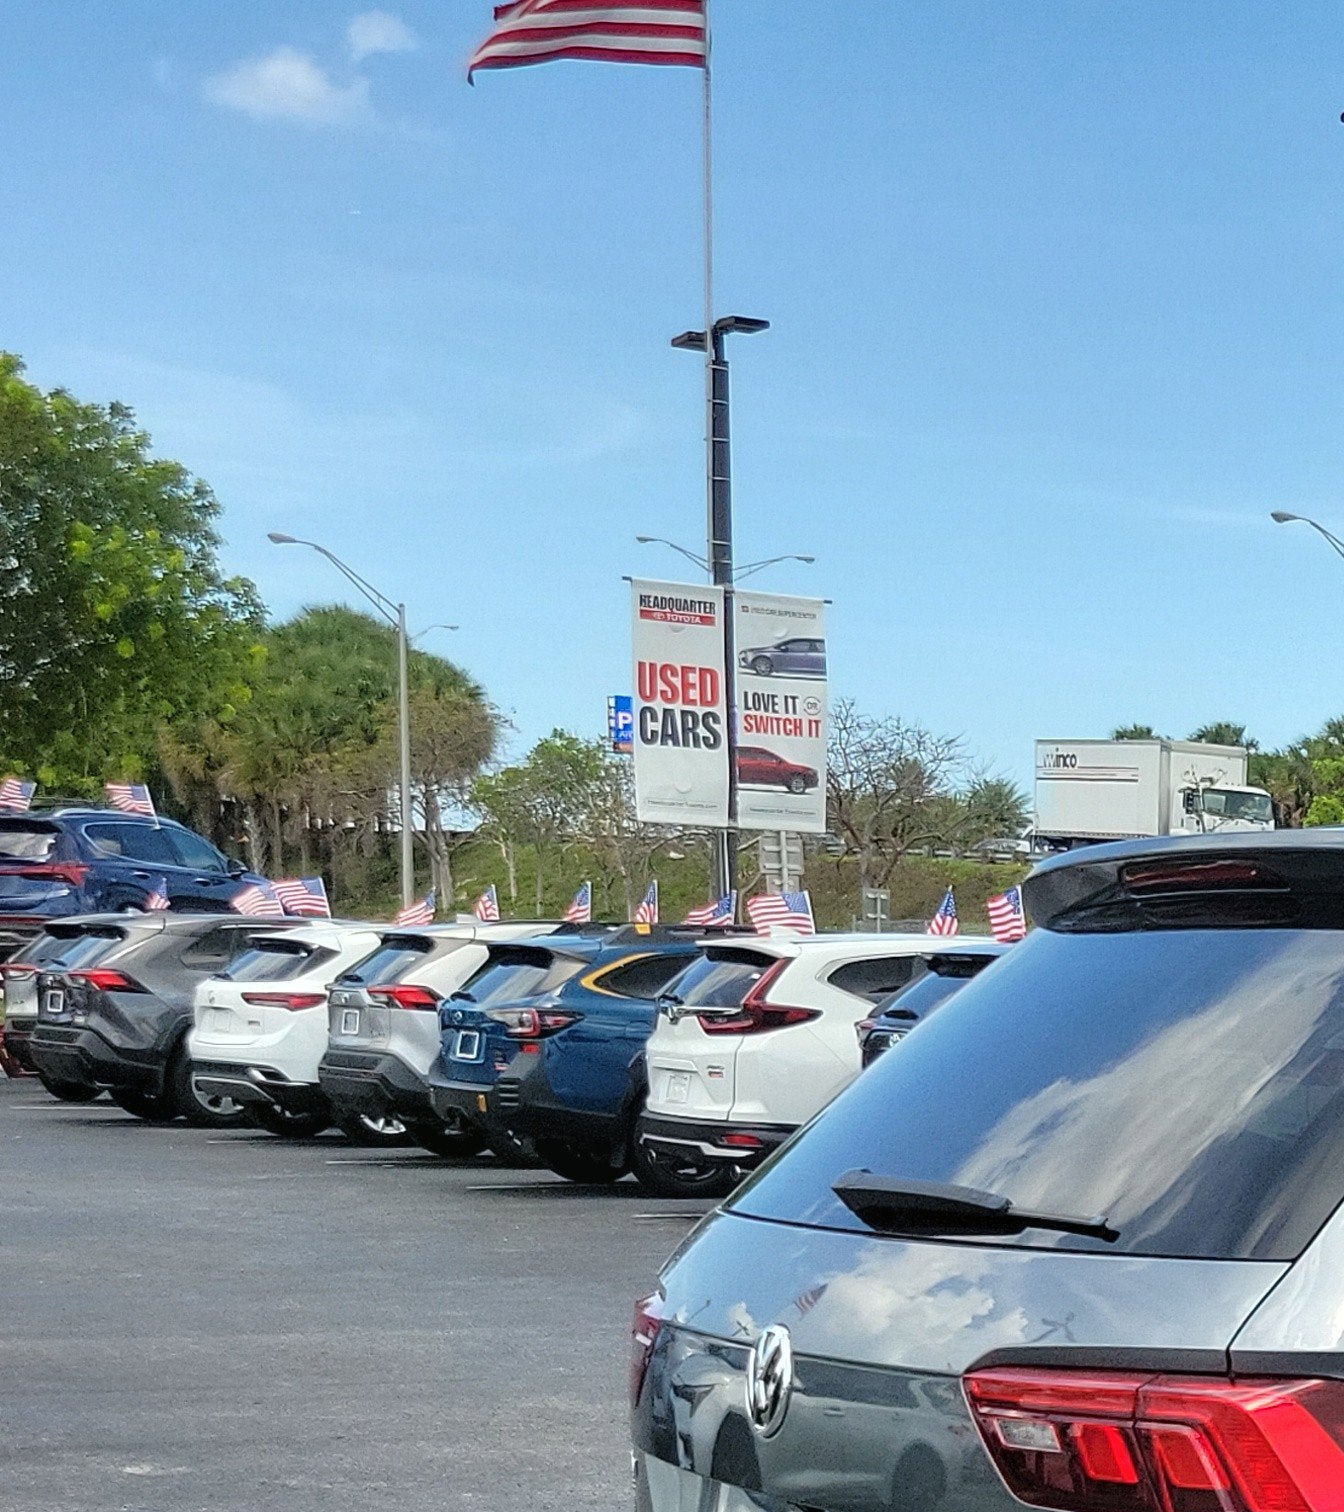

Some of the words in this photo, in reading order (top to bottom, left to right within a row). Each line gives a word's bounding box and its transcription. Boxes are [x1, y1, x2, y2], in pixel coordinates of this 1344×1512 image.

[639, 594, 716, 615] HEADQUARTER
[666, 612, 702, 625] TOYOTA
[637, 660, 720, 707] USED
[743, 691, 780, 714] LOVE
[784, 694, 799, 715] IT
[638, 705, 722, 750] CARS
[743, 714, 803, 738] SWITCH
[808, 718, 822, 739] IT
